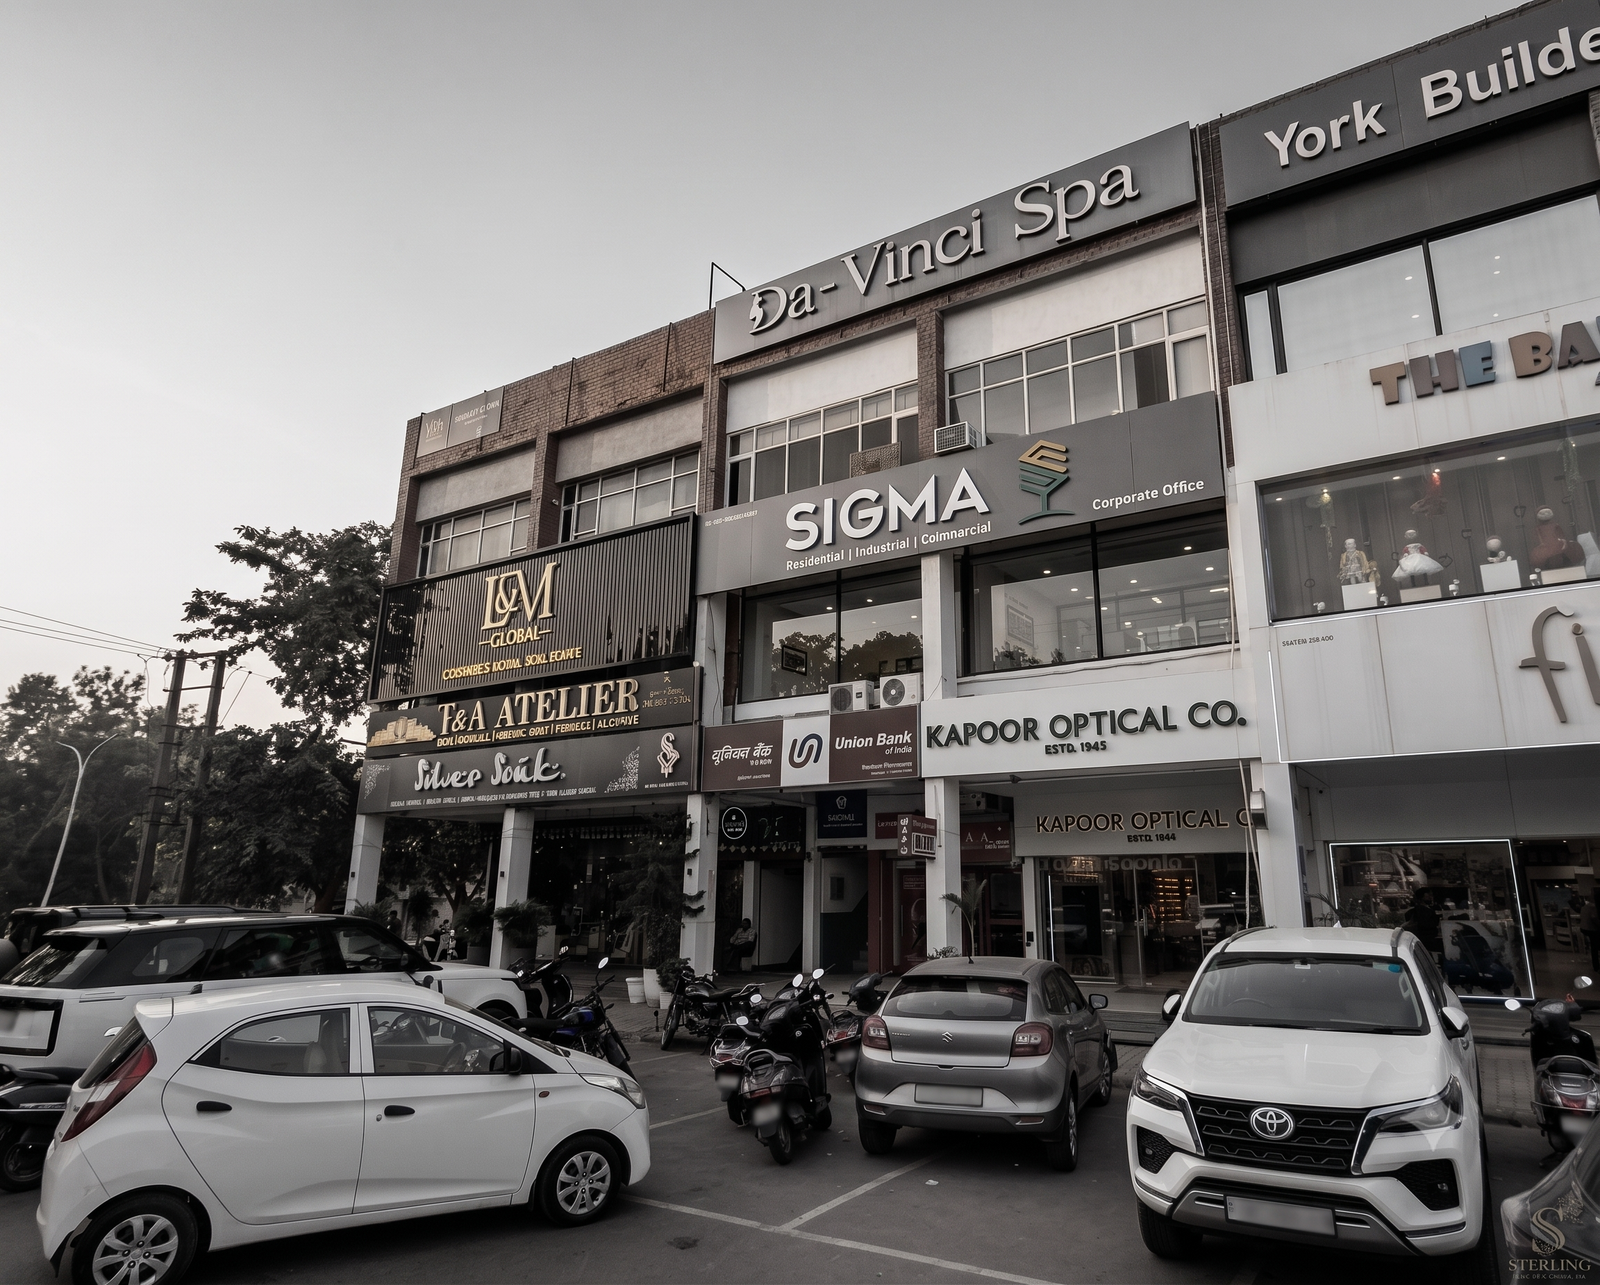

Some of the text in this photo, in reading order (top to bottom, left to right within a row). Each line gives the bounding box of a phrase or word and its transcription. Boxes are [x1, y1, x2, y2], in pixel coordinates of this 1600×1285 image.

[1264, 100, 1387, 168] York
[1013, 163, 1140, 243] Spa
[1369, 314, 1600, 406] THE BA
[785, 467, 989, 550] SIGMA
[1092, 478, 1205, 511] Corporate Office
[786, 550, 845, 571] Residential
[855, 537, 910, 558] Industrial
[490, 625, 541, 648] GLOBAL
[494, 678, 640, 729] ATELIER
[835, 730, 913, 750] Union Bank
[926, 698, 1248, 749] KAPOOR OPTICAL CO.
[885, 744, 913, 755] of India
[1080, 740, 1108, 753] 1945
[414, 758, 483, 791] Silver
[1035, 812, 1126, 834] KAPOOR
[1130, 808, 1230, 831] OPTICAL
[1154, 832, 1177, 842] 1844
